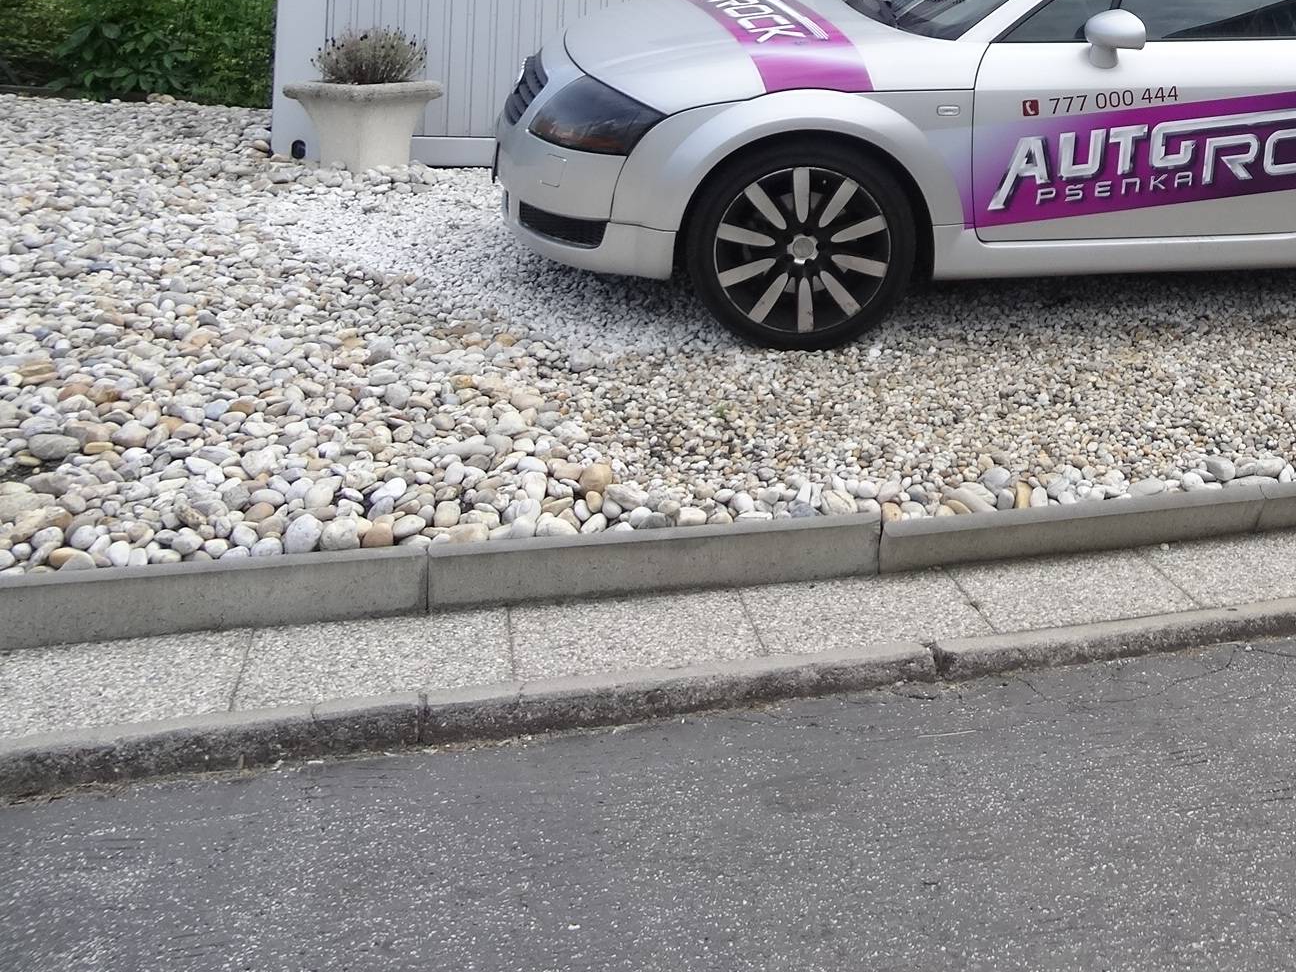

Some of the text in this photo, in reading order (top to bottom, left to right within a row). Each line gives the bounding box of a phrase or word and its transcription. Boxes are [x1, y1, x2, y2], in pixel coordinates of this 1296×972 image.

[1049, 85, 1179, 115] 777 000 444
